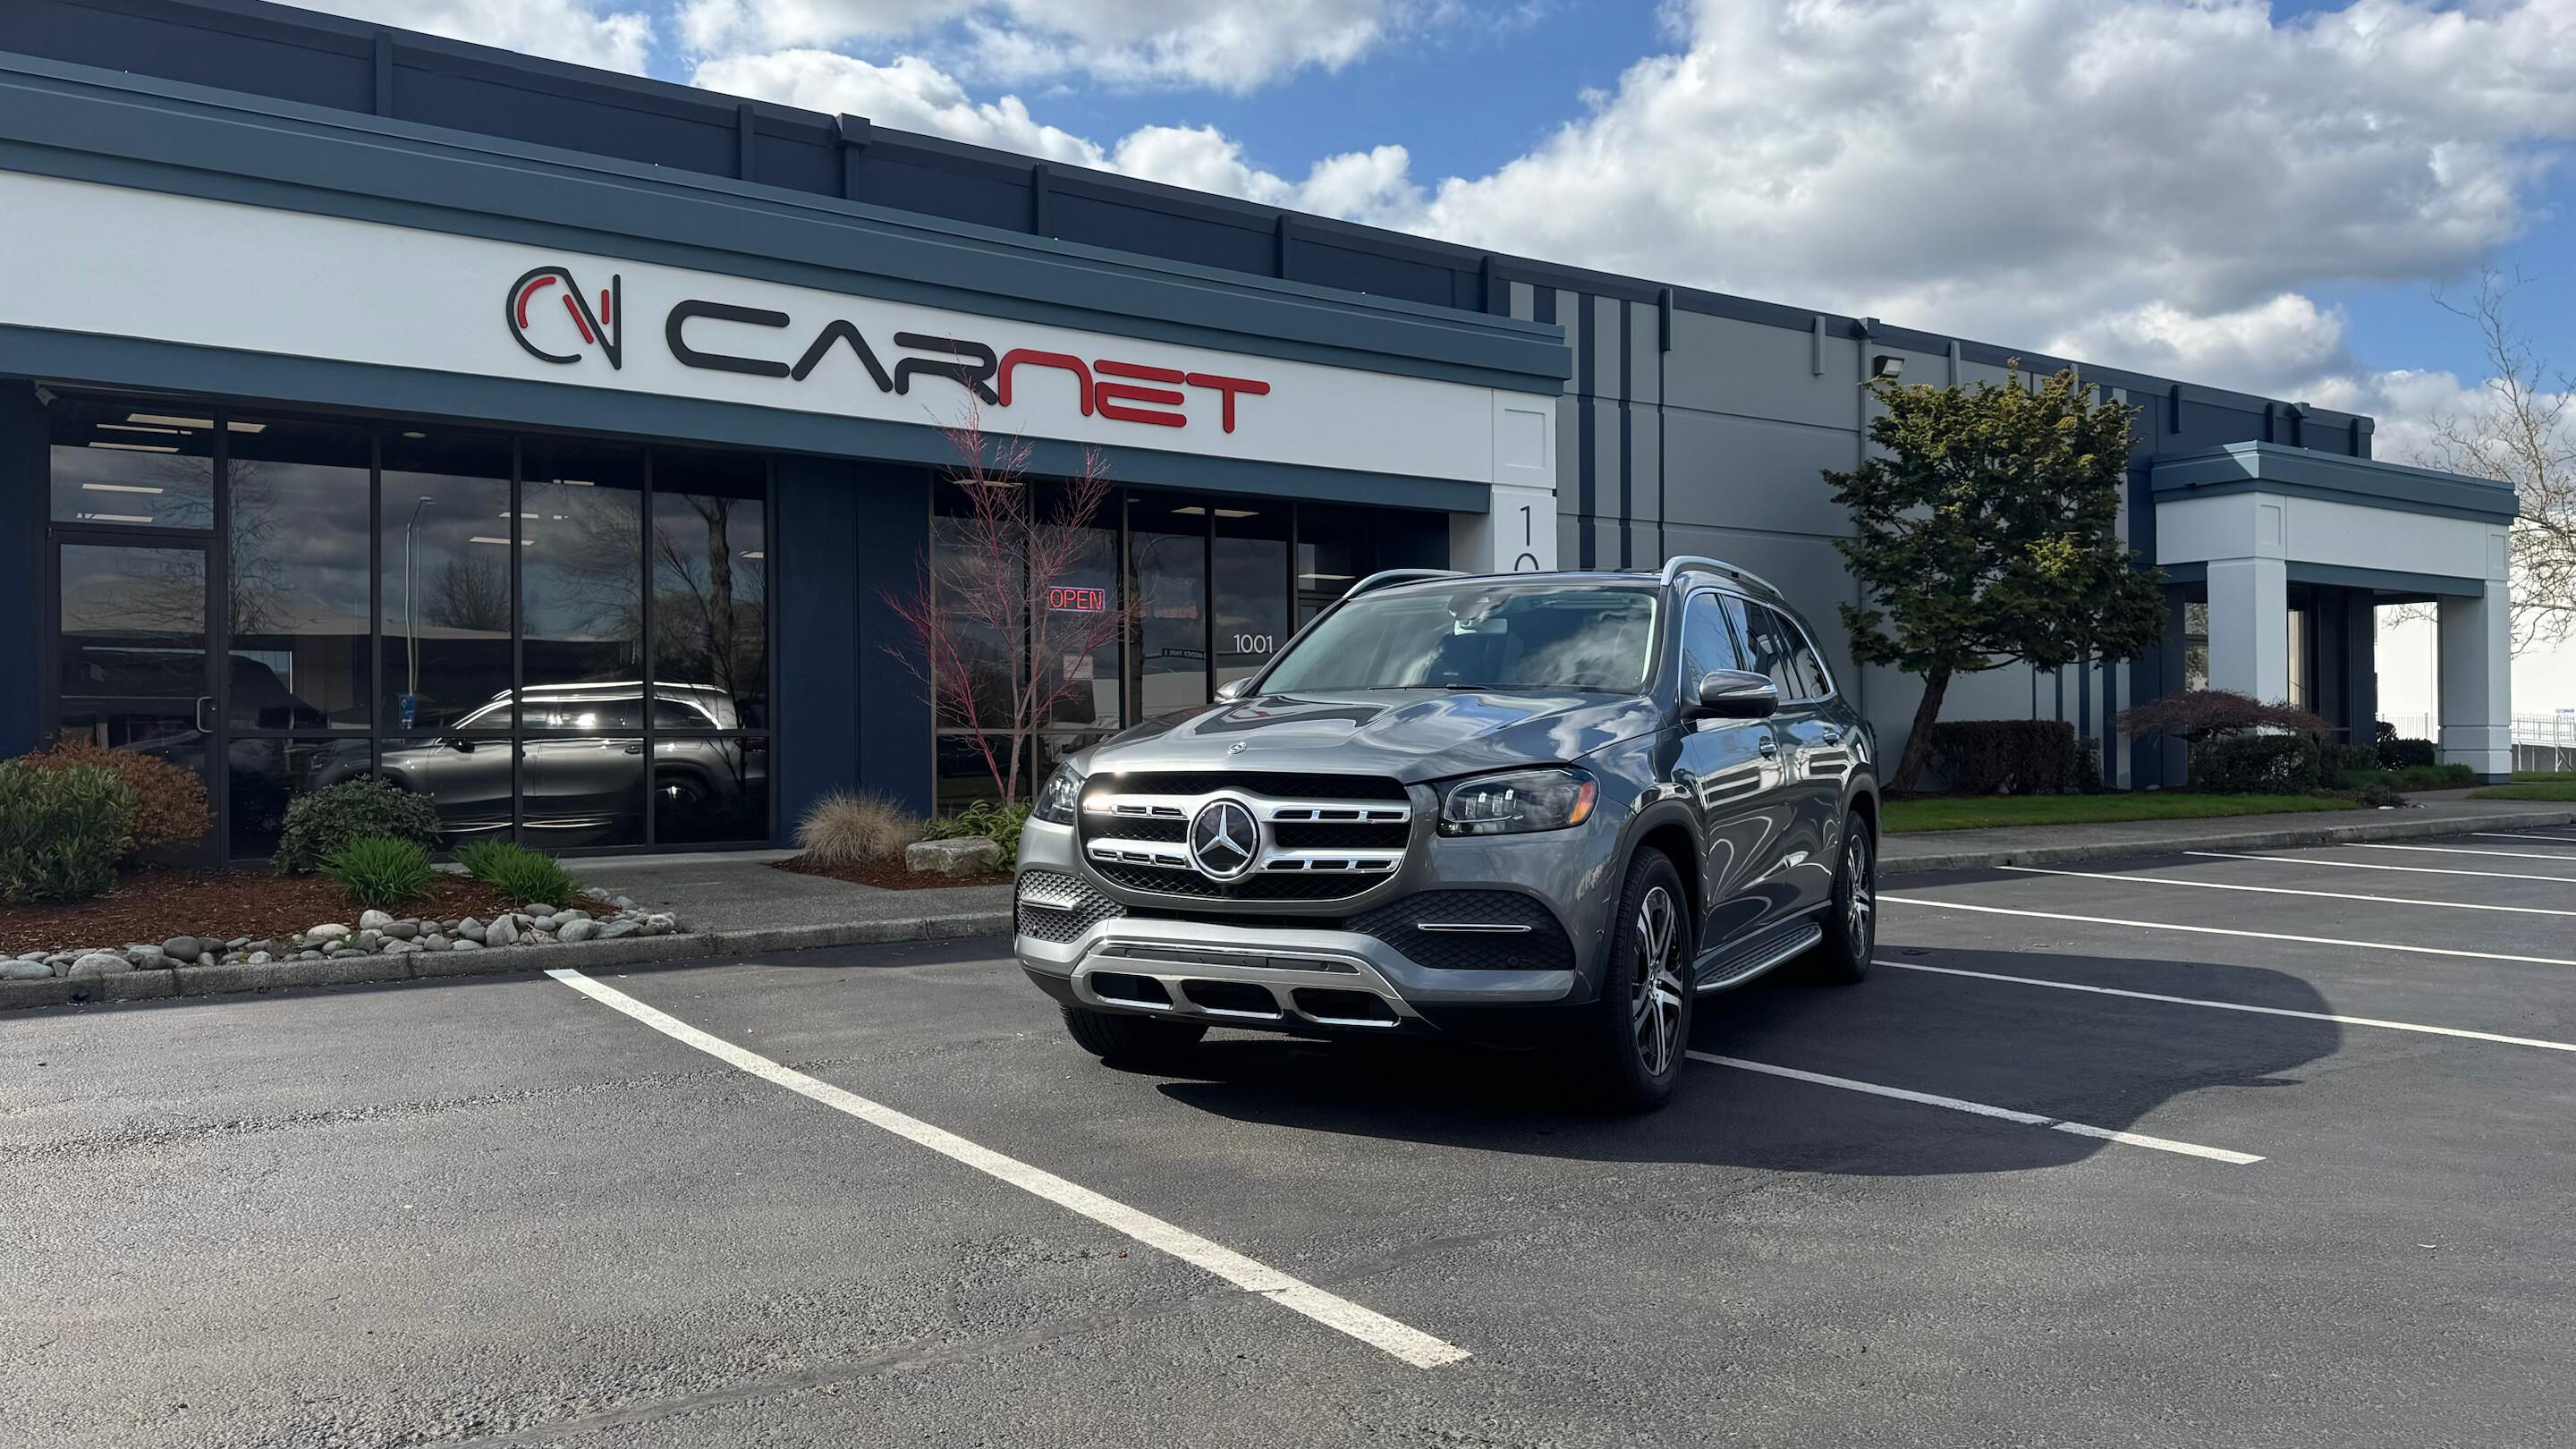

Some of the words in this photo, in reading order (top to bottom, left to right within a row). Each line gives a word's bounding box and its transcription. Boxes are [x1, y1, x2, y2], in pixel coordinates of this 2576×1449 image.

[665, 299, 1270, 433] CARNET
[1049, 589, 1103, 611] OPEN
[1233, 633, 1272, 654] 1001
